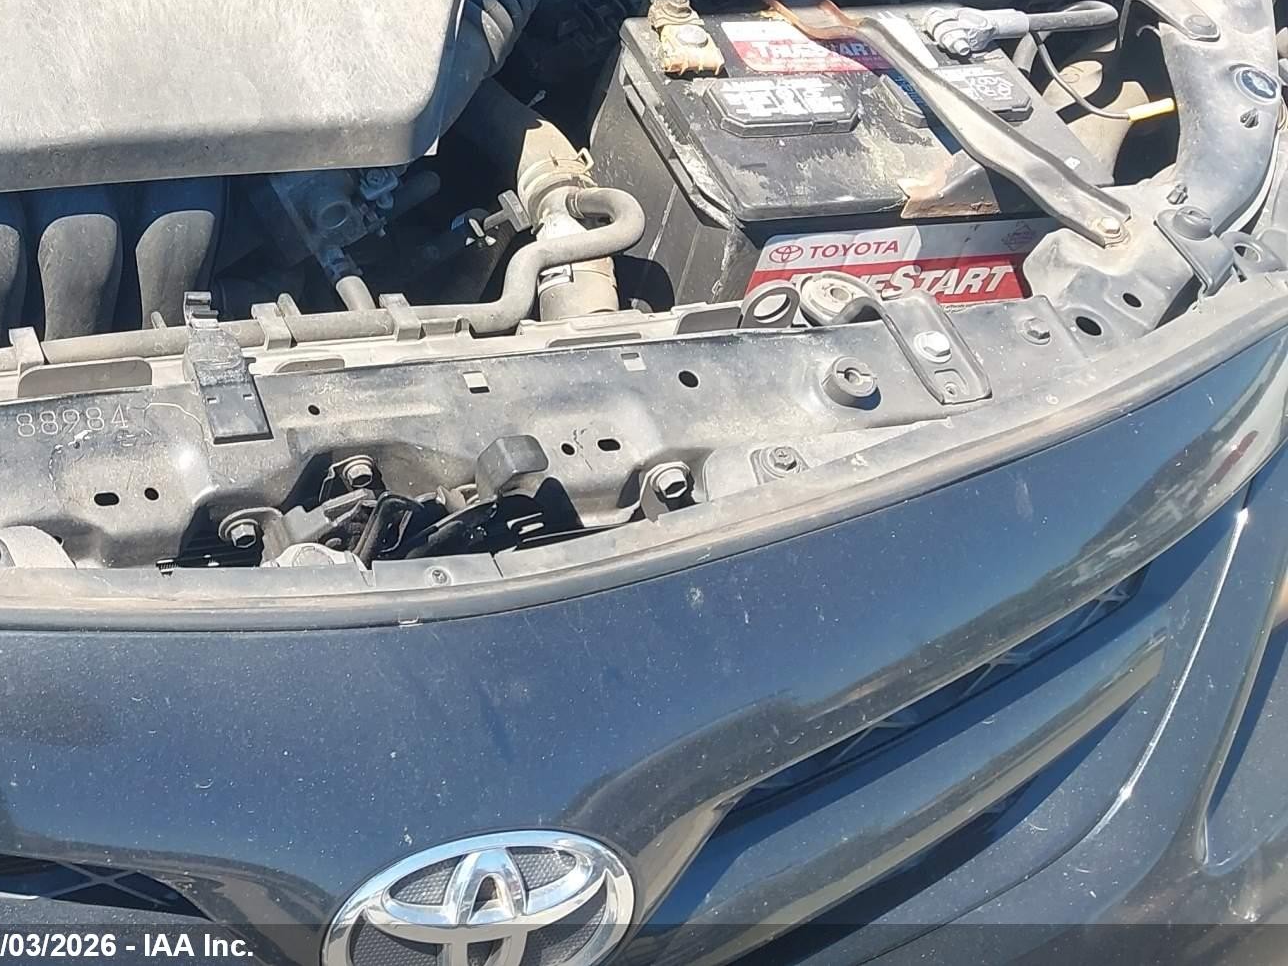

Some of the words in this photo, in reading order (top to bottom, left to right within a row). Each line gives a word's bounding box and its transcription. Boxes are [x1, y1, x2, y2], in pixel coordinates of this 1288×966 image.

[809, 240, 899, 259] TOYOTA
[790, 265, 1014, 296] ESTART
[16, 403, 129, 437] 88984
